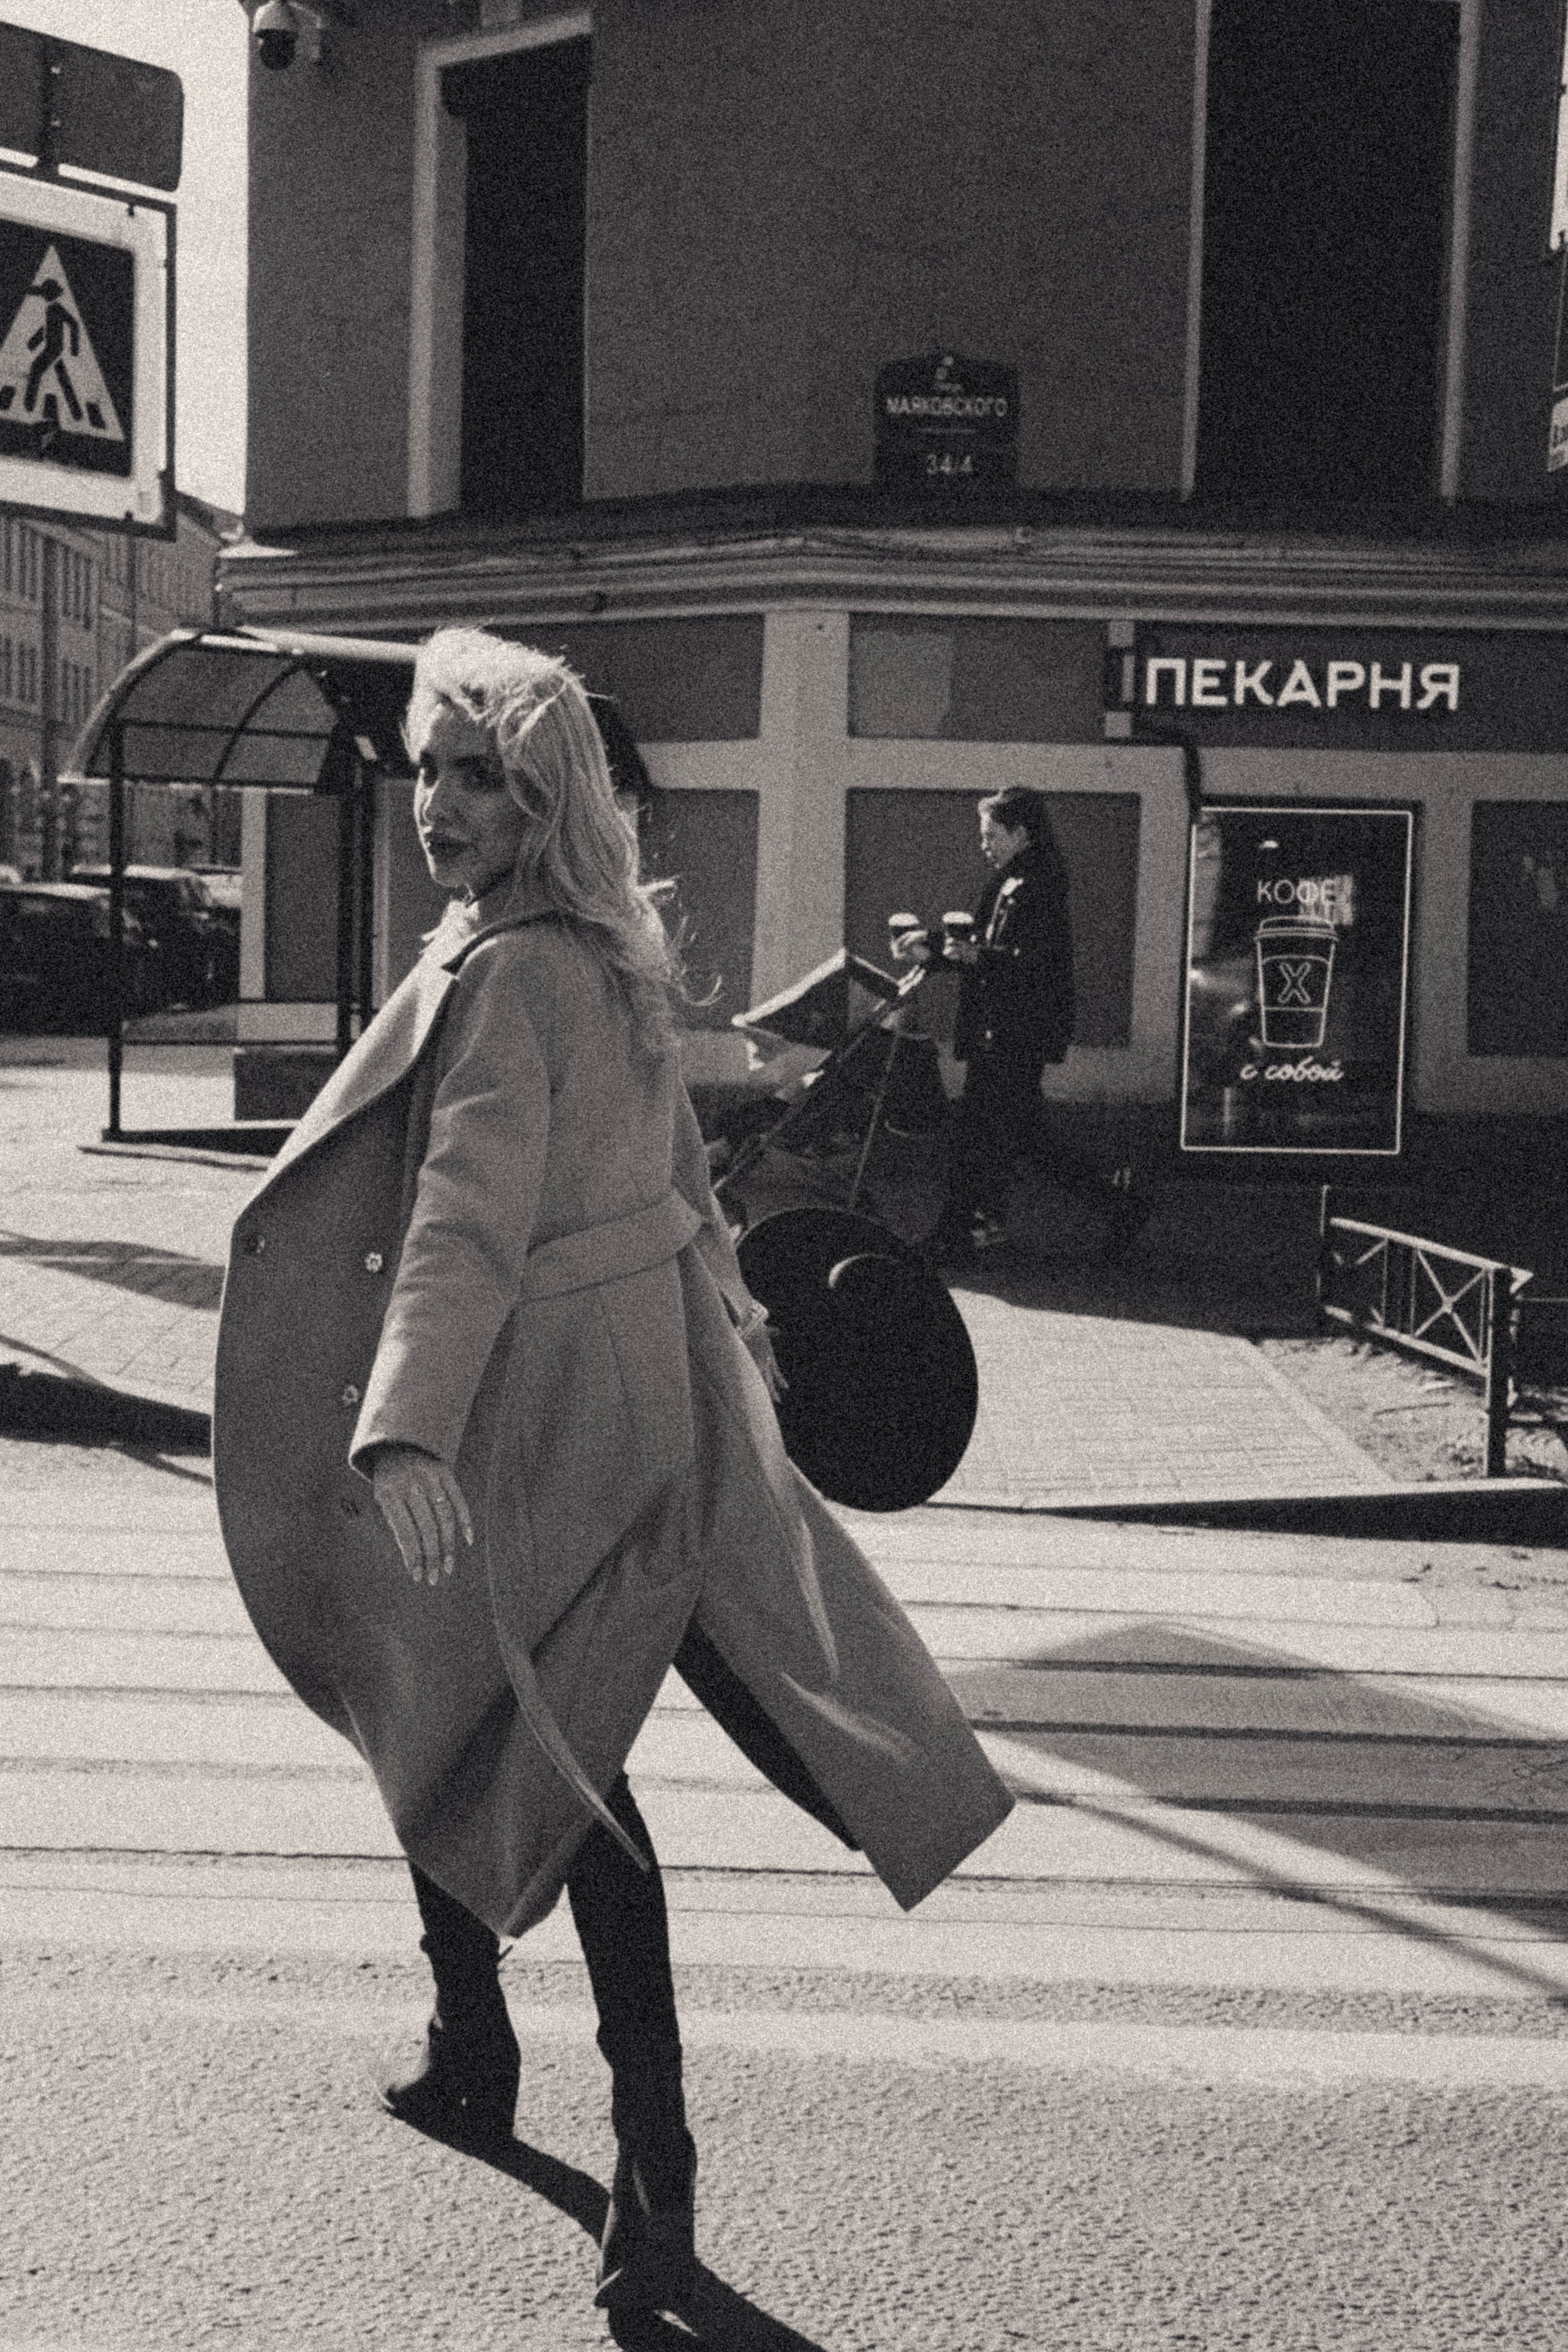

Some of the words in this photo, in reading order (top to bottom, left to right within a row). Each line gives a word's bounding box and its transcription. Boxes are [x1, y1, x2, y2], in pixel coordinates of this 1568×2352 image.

[886, 396, 1008, 417] МАЯКОВСКОГО
[1145, 657, 1460, 710] ПЕКАРНЯ
[1257, 878, 1336, 905] КОФЕ
[1264, 1055, 1344, 1082] собой
